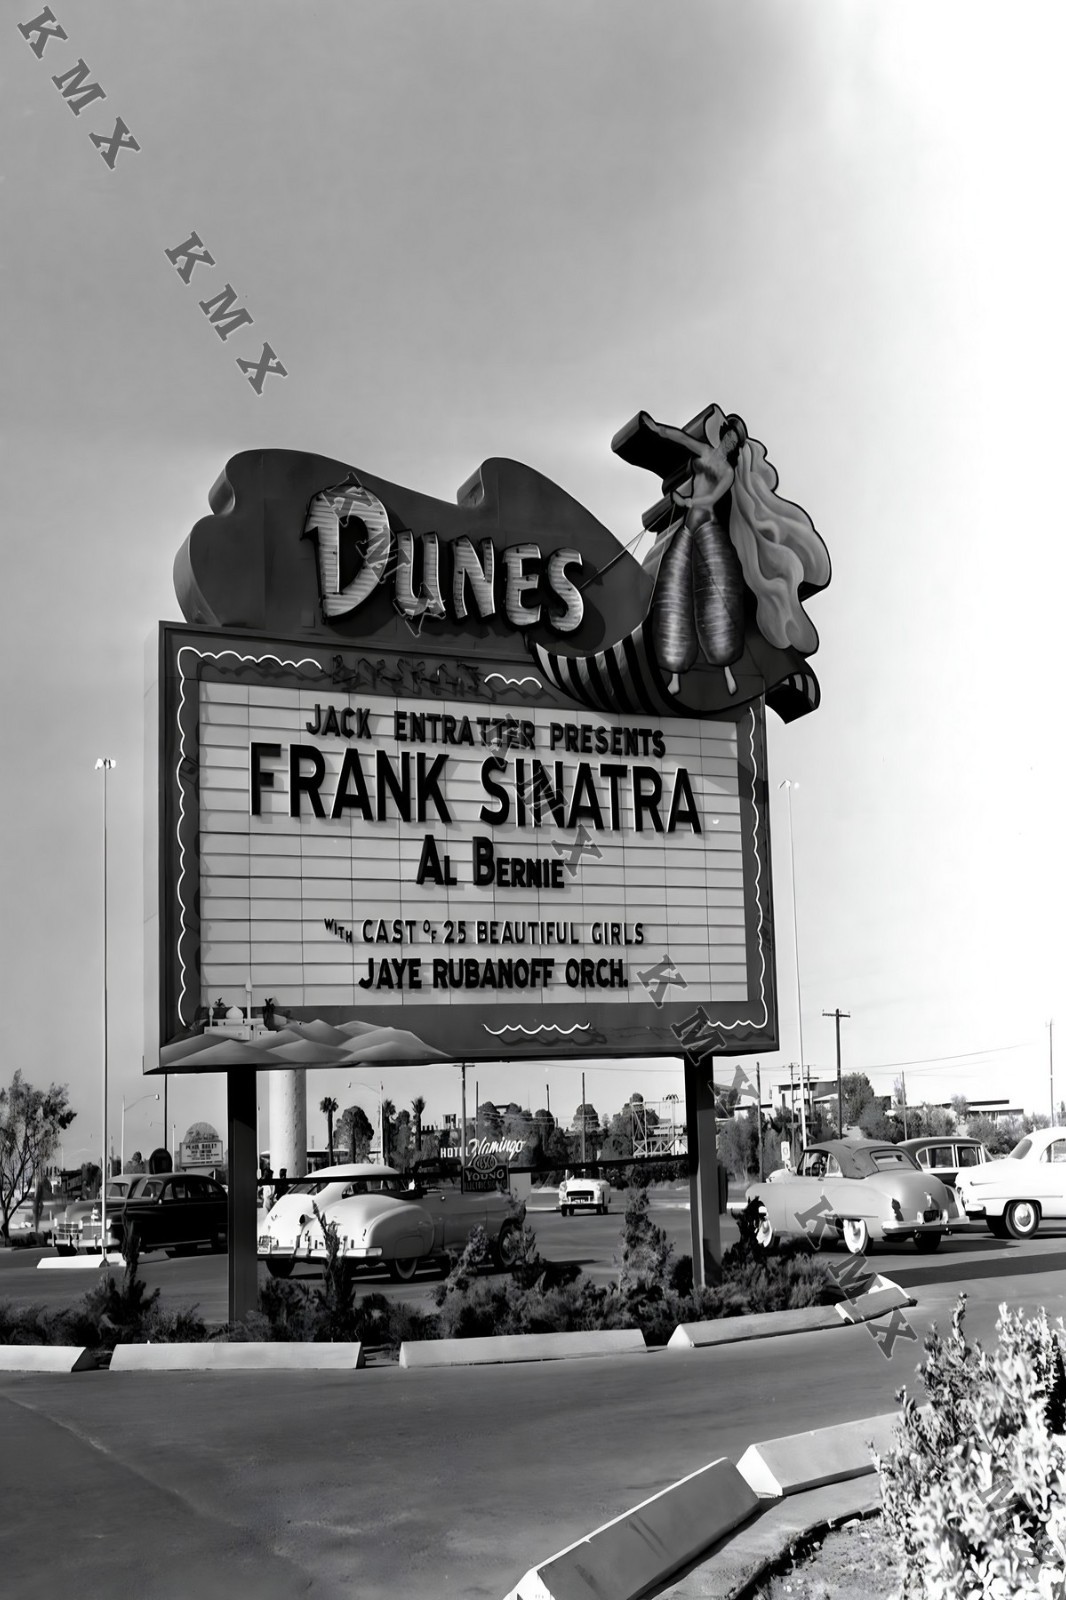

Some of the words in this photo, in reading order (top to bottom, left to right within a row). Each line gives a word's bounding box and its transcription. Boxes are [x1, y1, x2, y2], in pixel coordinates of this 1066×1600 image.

[302, 484, 585, 632] DUNES
[306, 703, 372, 739] JACK
[394, 711, 535, 750] ENTRATTER
[550, 722, 666, 758] PRESENTS
[250, 742, 452, 824] FRANK
[479, 756, 702, 834] SINATRA
[416, 834, 457, 886] AL
[472, 836, 565, 888] BERNIE
[324, 918, 352, 943] WITH
[362, 919, 416, 944] CAST
[422, 919, 437, 944] OF
[443, 920, 466, 944] 25
[475, 920, 579, 945] BEAUTIFUL
[591, 922, 644, 945] GIRLS
[358, 958, 422, 989] JAYE
[433, 958, 555, 989] RUBANOFF
[565, 958, 629, 988] ORCH.
